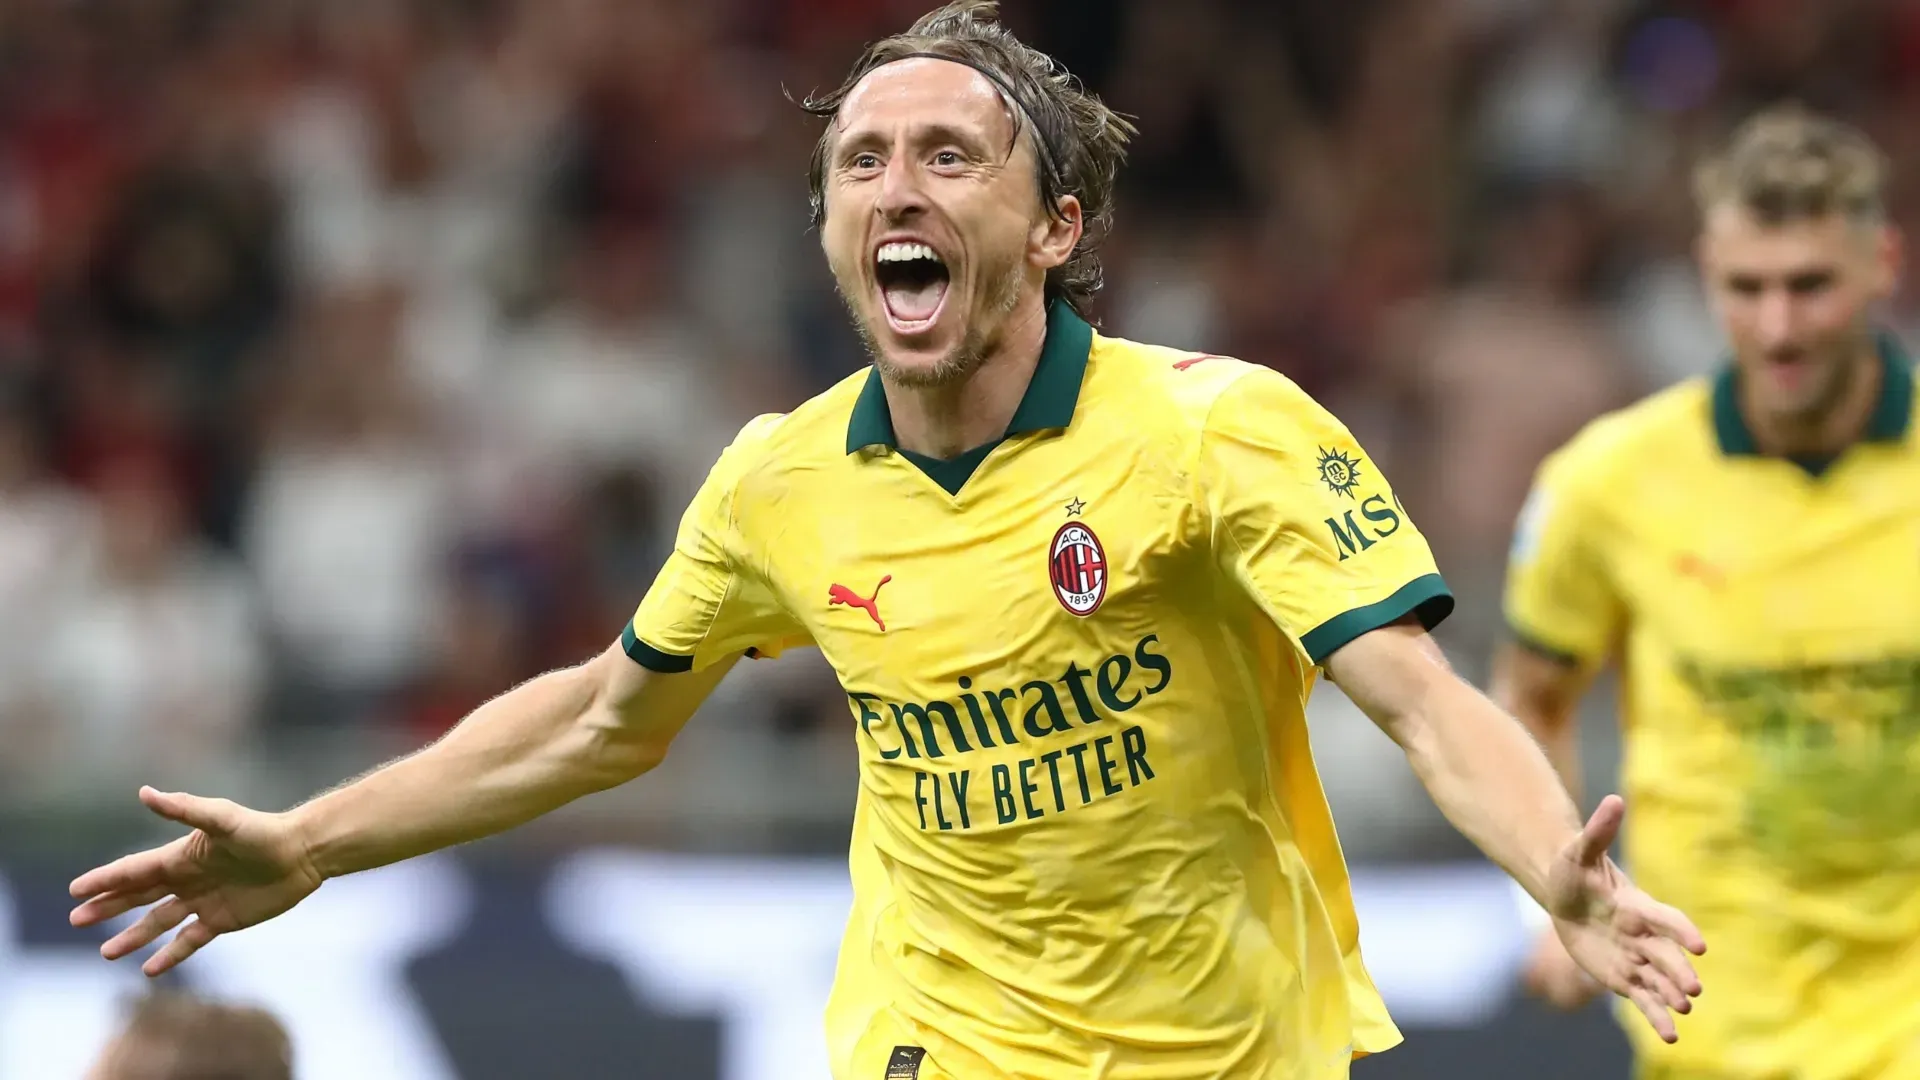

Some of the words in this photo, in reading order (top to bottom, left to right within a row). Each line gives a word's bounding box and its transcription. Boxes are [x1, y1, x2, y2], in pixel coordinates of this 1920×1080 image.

[1060, 529, 1092, 549] ACM
[1323, 490, 1405, 562] MS
[1069, 592, 1096, 605] 1899
[847, 633, 1172, 760] Emirates
[914, 769, 970, 831] FLY
[991, 725, 1156, 825] BETTER
